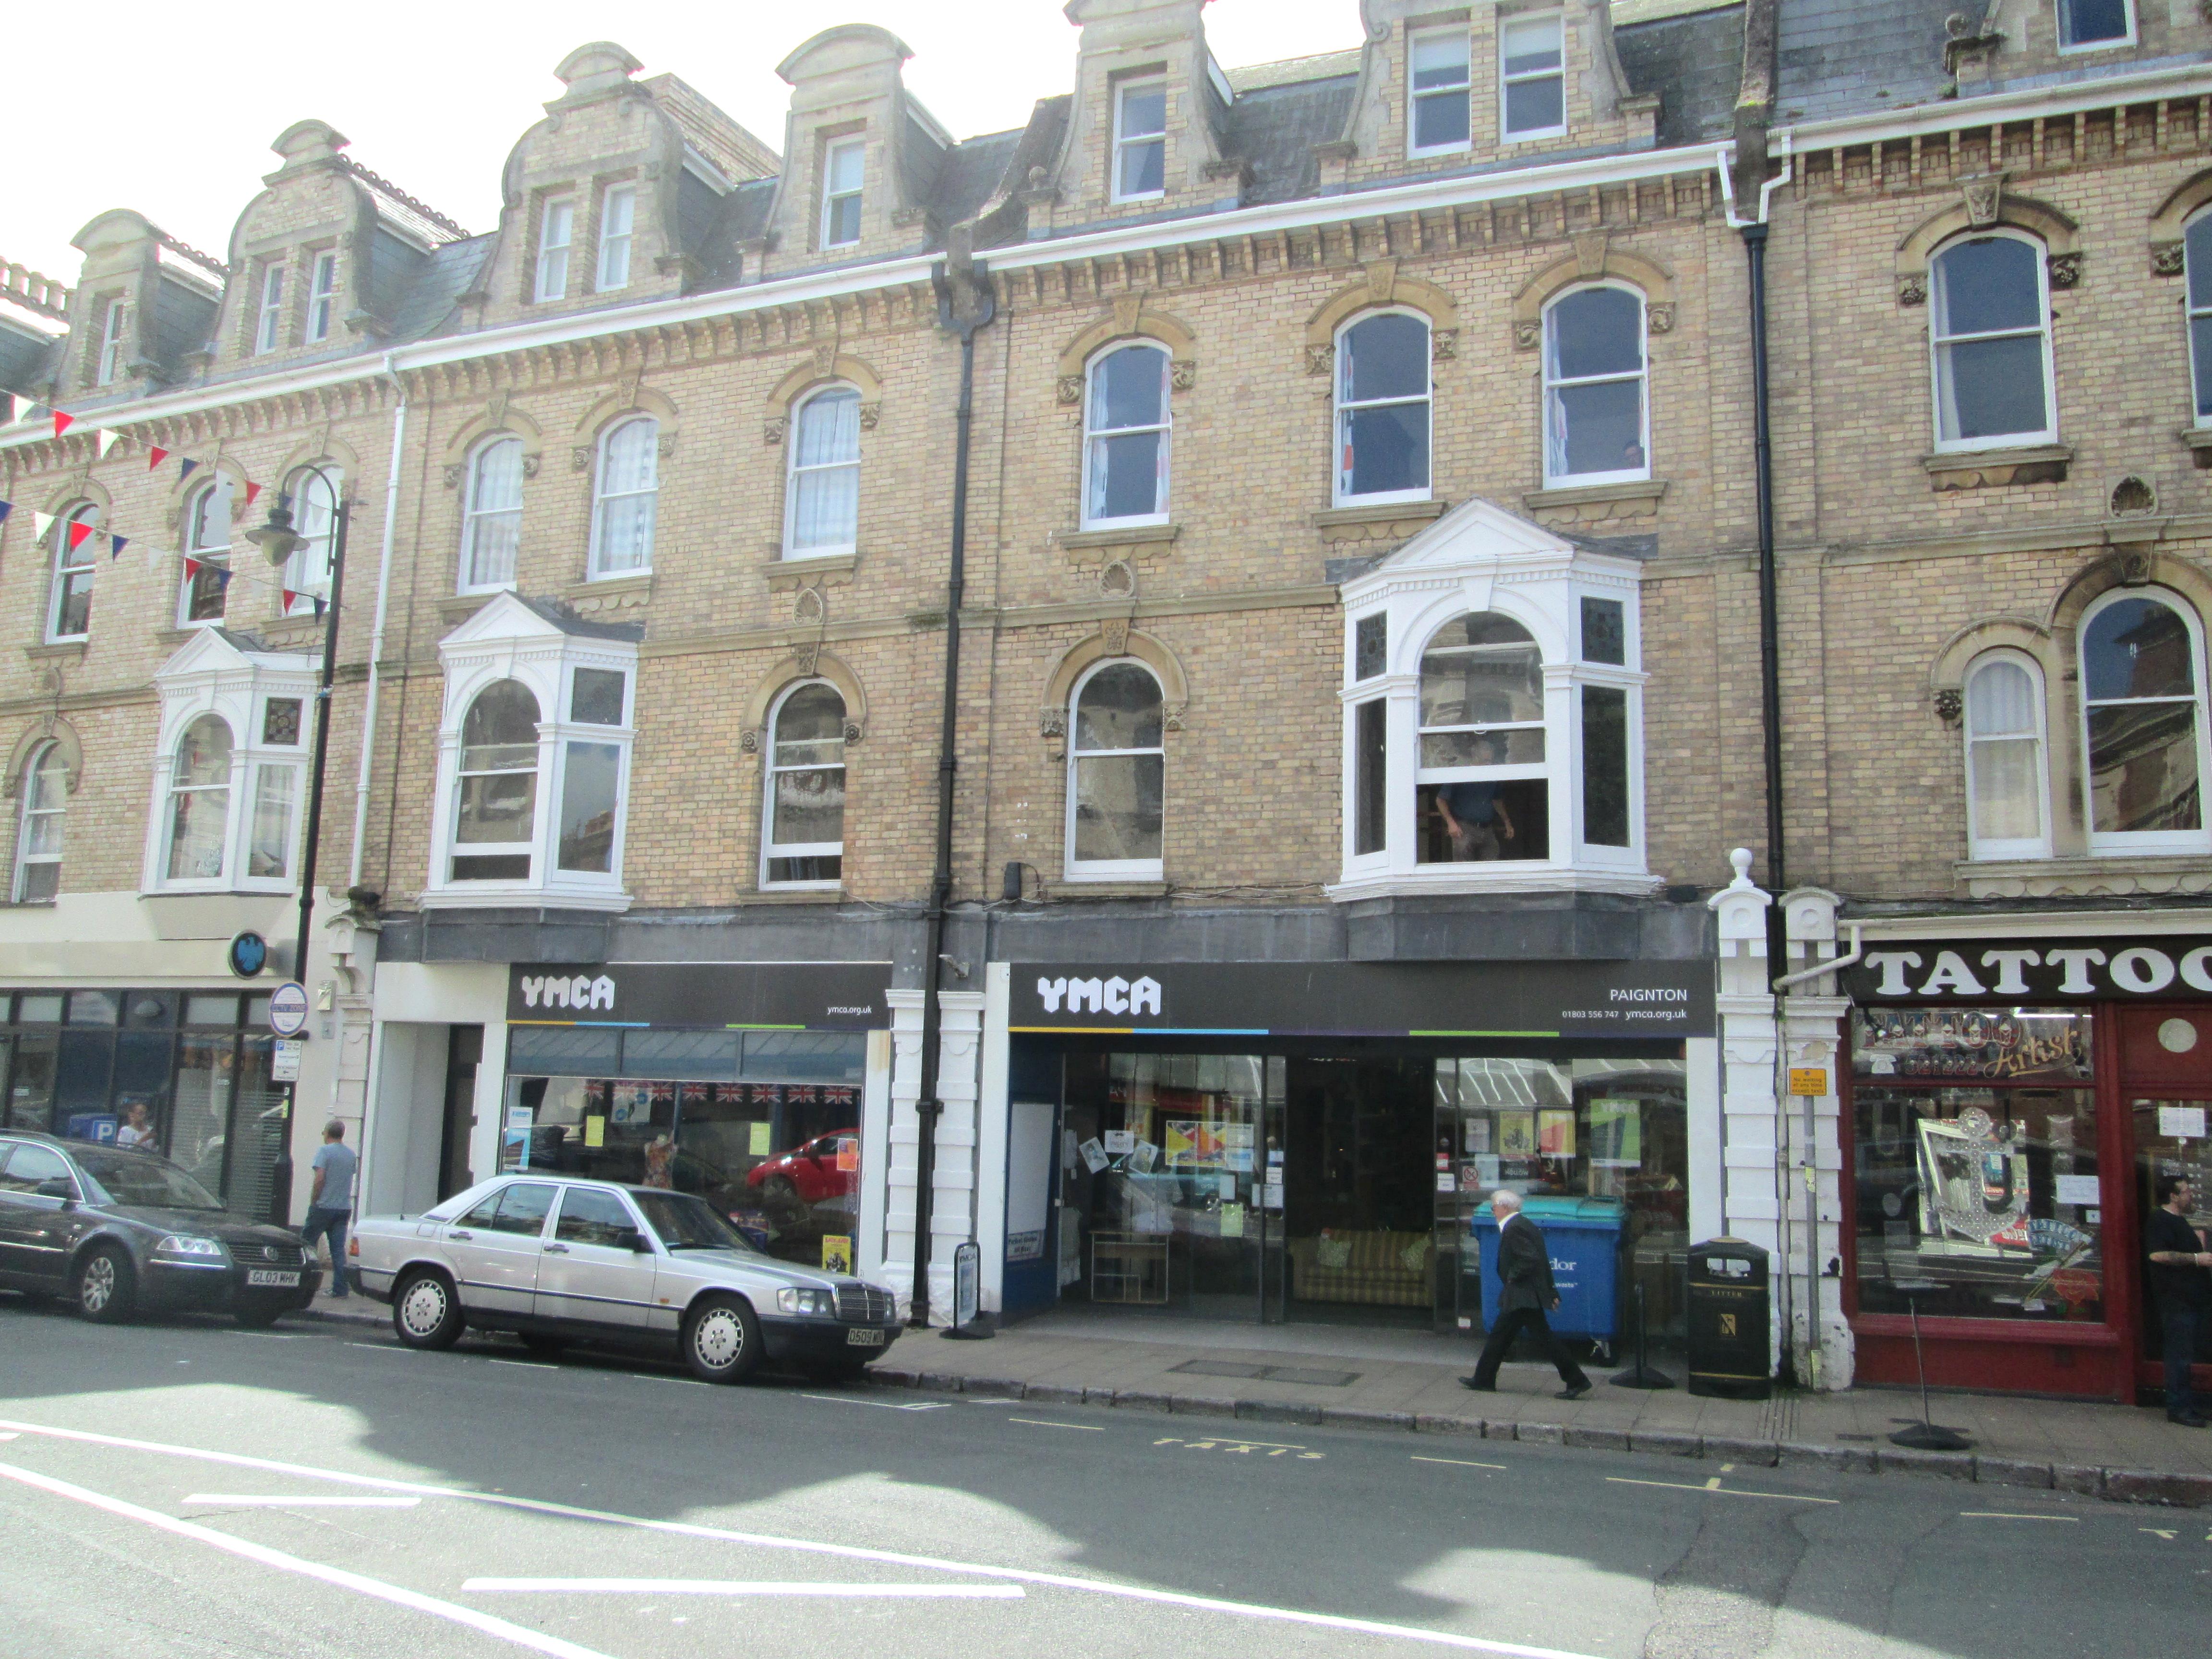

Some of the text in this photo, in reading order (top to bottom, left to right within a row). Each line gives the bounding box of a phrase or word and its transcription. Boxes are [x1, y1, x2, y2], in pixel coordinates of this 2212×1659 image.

[521, 974, 615, 1010] YMCA
[1037, 976, 1161, 1015] YMCA
[1610, 989, 1687, 1001] PAIGNTON
[827, 1005, 872, 1016] ymca.org.uk
[1625, 1009, 1687, 1020] ymca.org.uk
